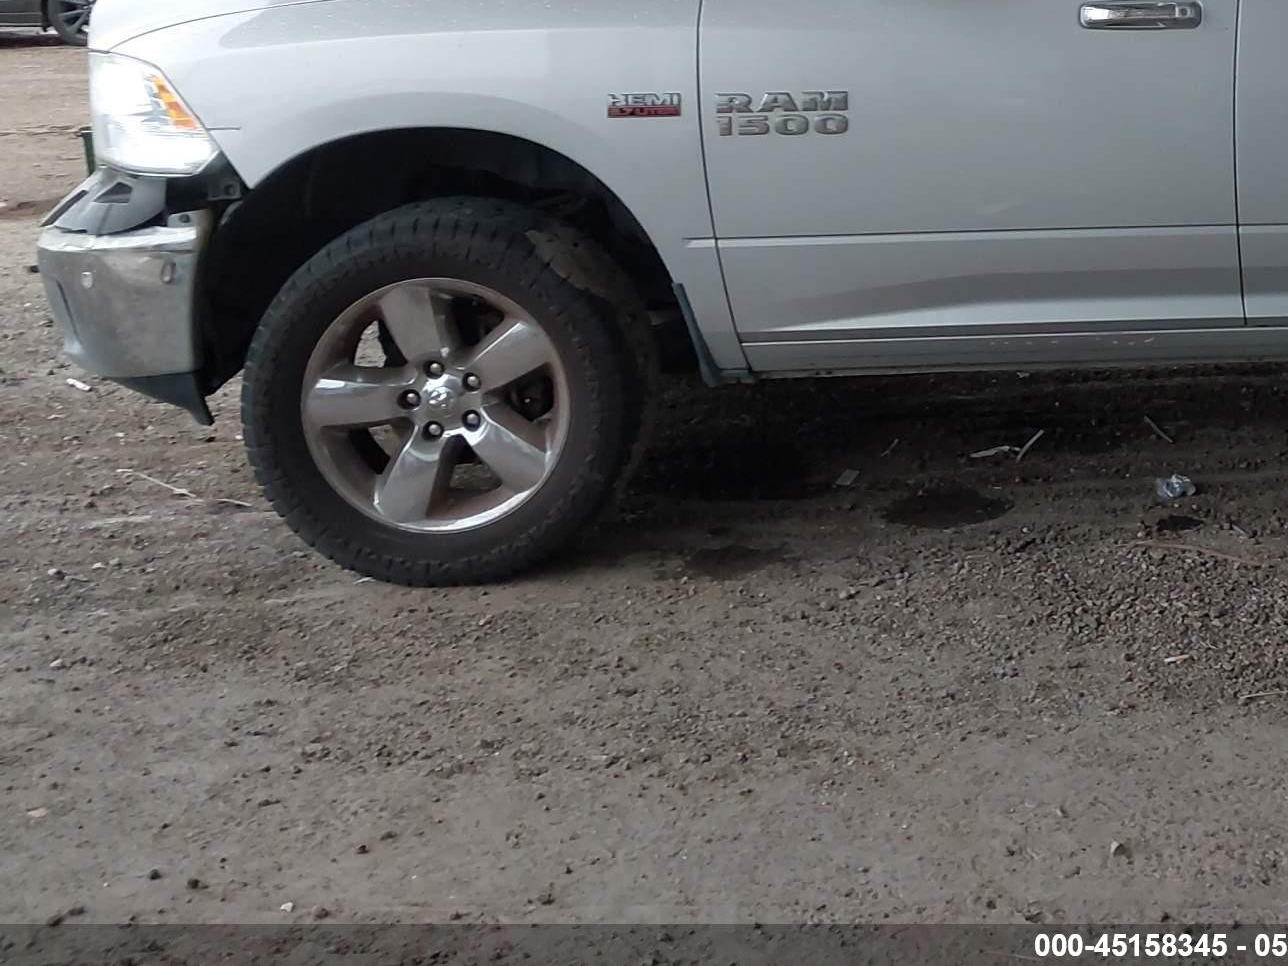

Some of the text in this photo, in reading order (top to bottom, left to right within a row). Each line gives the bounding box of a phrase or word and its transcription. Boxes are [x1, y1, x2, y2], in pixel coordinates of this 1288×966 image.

[607, 92, 681, 106] HEMI
[716, 90, 849, 113] RAM
[716, 113, 849, 136] 1500
